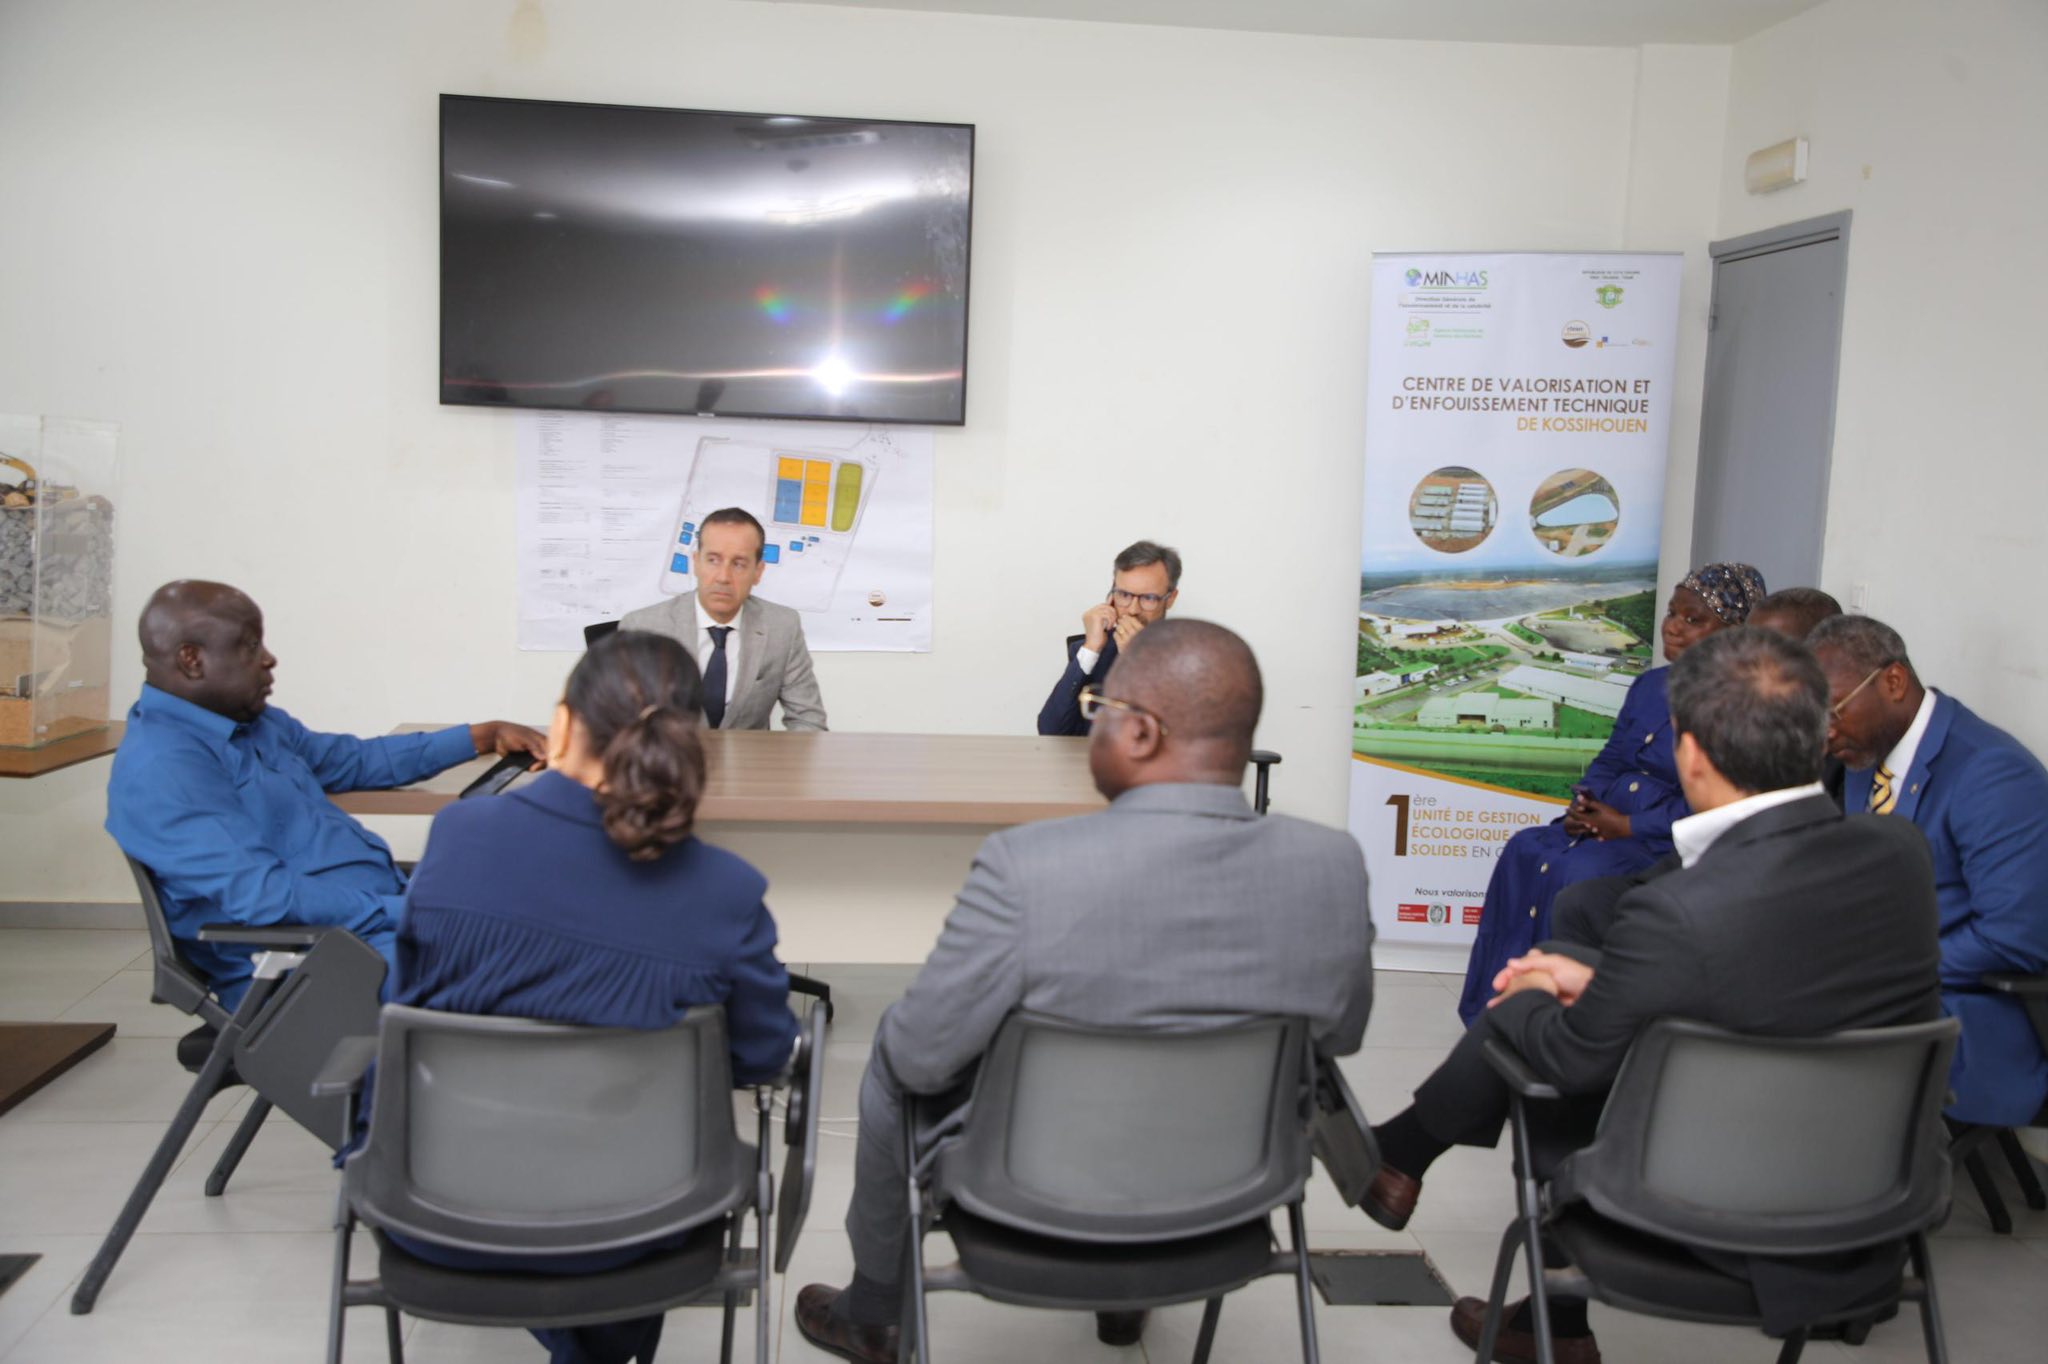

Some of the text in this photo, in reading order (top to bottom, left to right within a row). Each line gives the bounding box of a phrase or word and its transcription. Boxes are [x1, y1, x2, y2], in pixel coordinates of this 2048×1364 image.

[1423, 270, 1488, 286] MINHAS
[1402, 376, 1650, 394] CENTRE DE VALORISATION ET
[1392, 395, 1649, 414] D'ENFOUISSEMENT TECHNIQUE
[1517, 417, 1647, 432] DE KOSSIHOUEN
[1412, 807, 1541, 825] UNITÉ DE GESTION
[1411, 823, 1509, 841] ÉCOLOGIQUE
[1410, 843, 1467, 857] SOLIDES
[1471, 846, 1490, 858] EN
[1414, 887, 1439, 896] Nous
